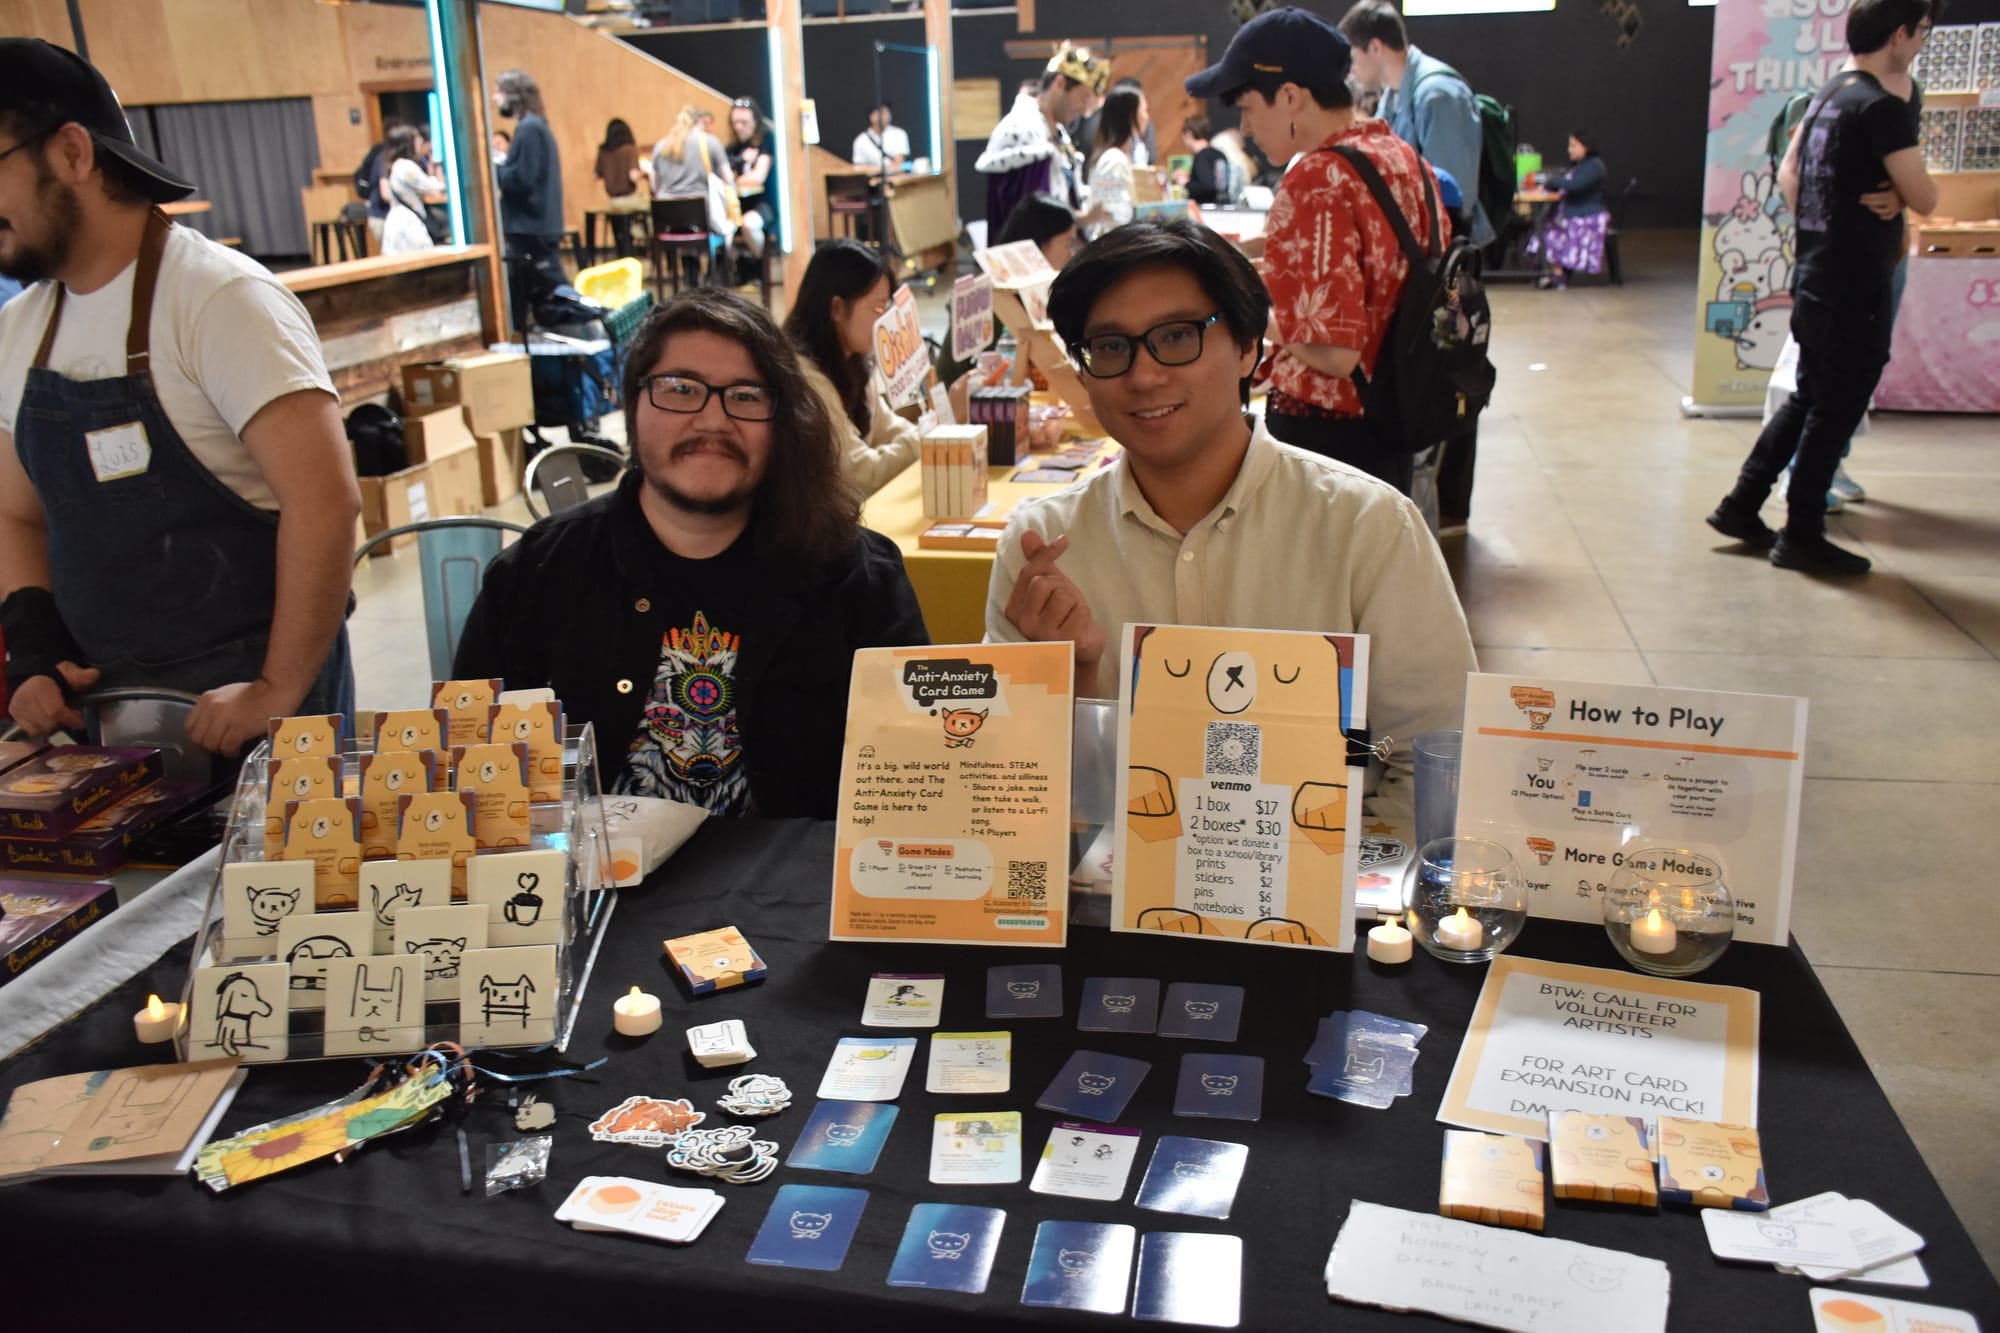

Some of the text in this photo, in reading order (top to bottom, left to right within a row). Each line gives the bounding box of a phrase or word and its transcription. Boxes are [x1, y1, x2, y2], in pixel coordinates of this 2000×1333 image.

[94, 441, 138, 474] Luis
[908, 670, 989, 684] Anti-Anxiety
[919, 684, 985, 697] Card Game
[1570, 700, 1724, 737] How to Play
[857, 762, 872, 771] It's
[903, 762, 920, 770] wild
[923, 762, 950, 770] world
[1009, 761, 1038, 769] STEAM
[907, 776, 925, 784] and
[928, 776, 945, 784] The
[1018, 773, 1048, 781] silliness
[1527, 773, 1555, 789] You
[1663, 774, 1687, 782] Choose
[854, 789, 943, 799] Anti-Anxiety Card
[1210, 780, 1252, 792] venmo
[853, 803, 928, 812] Game is here to
[983, 806, 1005, 814] listen
[1195, 796, 1279, 817] 1 box $17
[852, 816, 875, 827] help!
[1190, 816, 1199, 830] 2
[1255, 819, 1282, 837] $30
[986, 829, 1016, 838] Players
[898, 847, 951, 856] Game Modes
[1228, 838, 1239, 847] we
[1241, 838, 1270, 849] donate
[1273, 841, 1279, 850] a
[1187, 845, 1202, 856] box
[1205, 848, 1214, 857] to
[1223, 848, 1283, 864] school/library
[1564, 847, 1713, 877] More Game Modes
[1196, 857, 1273, 874] prints $4
[1194, 872, 1273, 889] stickers $2
[1194, 886, 1272, 903] pins $6
[1193, 901, 1272, 918] notebooks $4
[1539, 983, 1697, 1018] BTW: CALL FOR
[1554, 999, 1677, 1028] VOLUNTEER
[1562, 1016, 1653, 1039] ARTISTS
[1521, 1055, 1688, 1093] FOR ART CARD
[1500, 1069, 1705, 1115] EXPANSION PACK!
[1408, 1219, 1480, 1239] TRY IT
